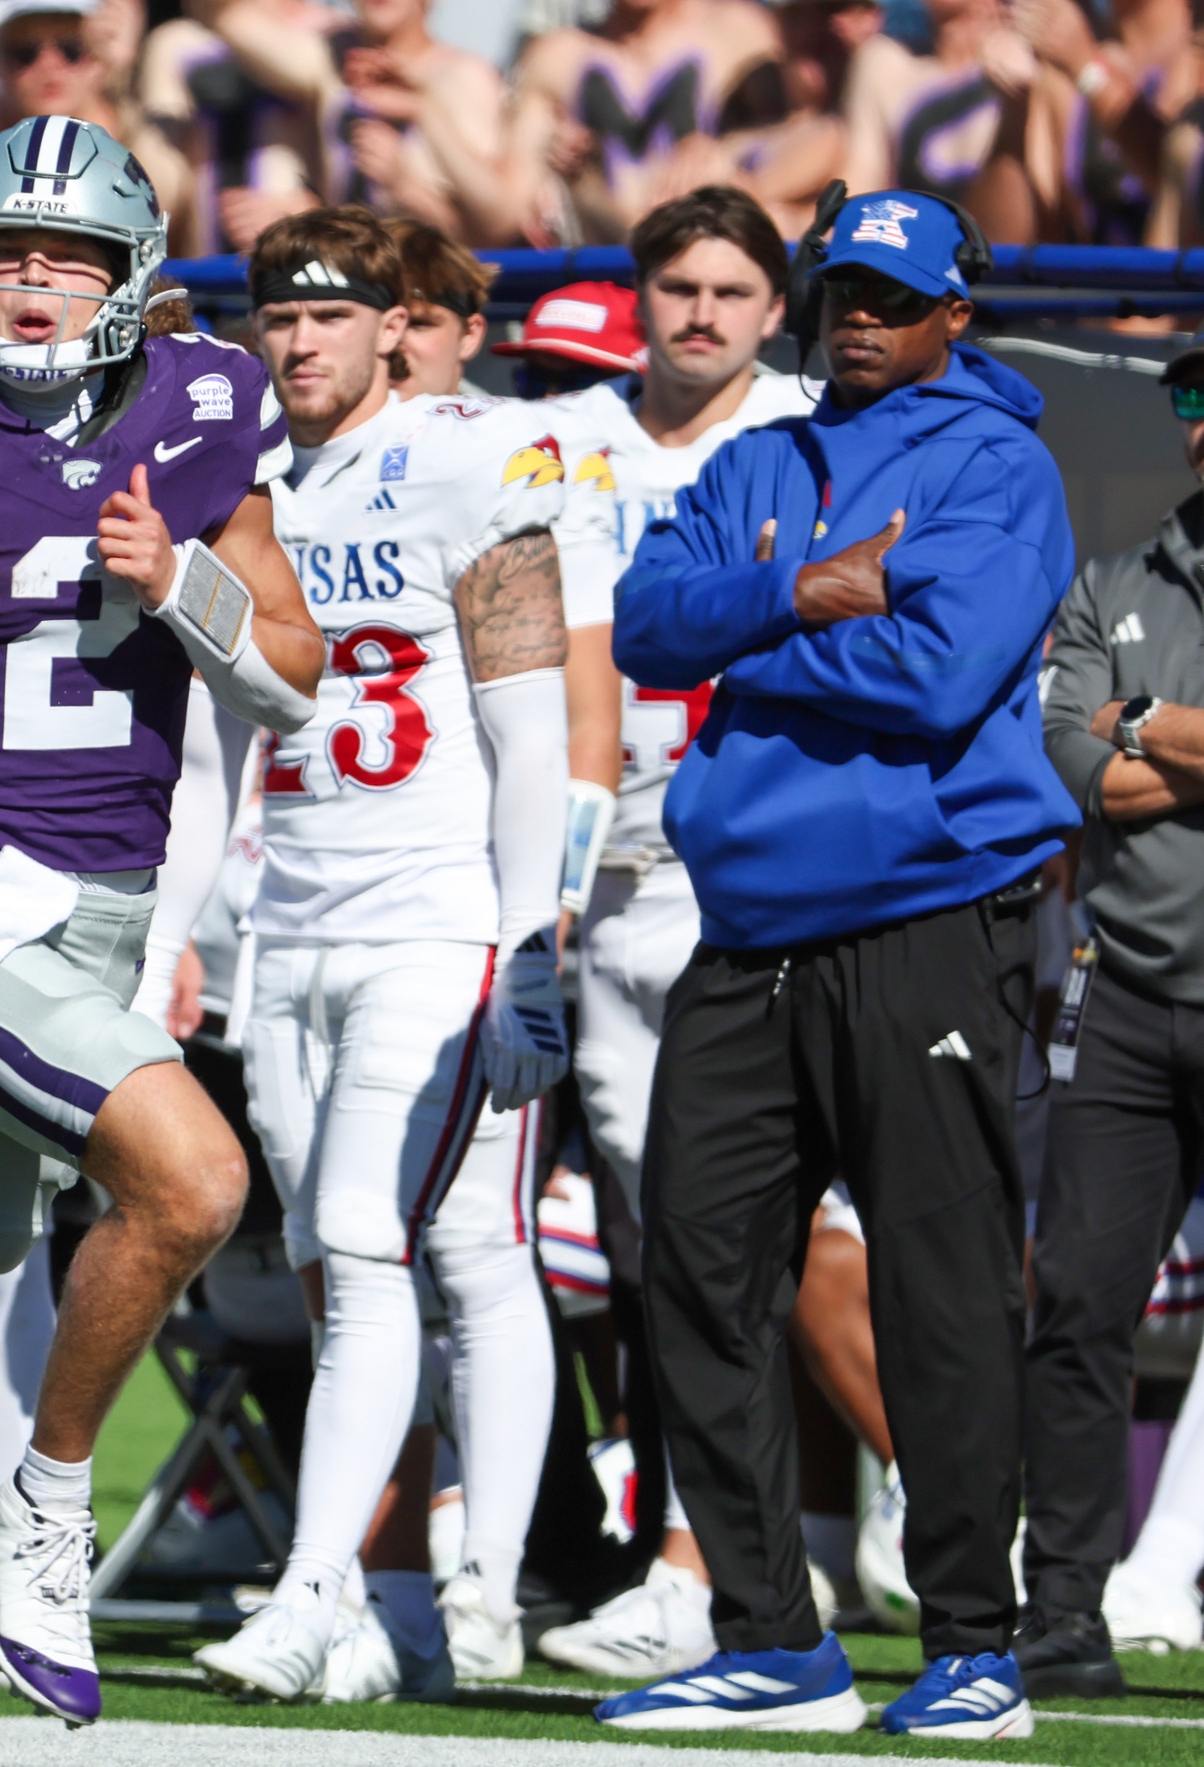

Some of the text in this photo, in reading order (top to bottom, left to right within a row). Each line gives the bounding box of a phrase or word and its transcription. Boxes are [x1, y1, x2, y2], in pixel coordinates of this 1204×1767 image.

[13, 199, 68, 214] K-STATE
[192, 386, 230, 398] purple
[201, 398, 231, 406] wave
[195, 409, 231, 417] AUCTION
[295, 541, 405, 605] SAS
[2, 536, 140, 750] 2
[264, 619, 440, 798] 3
